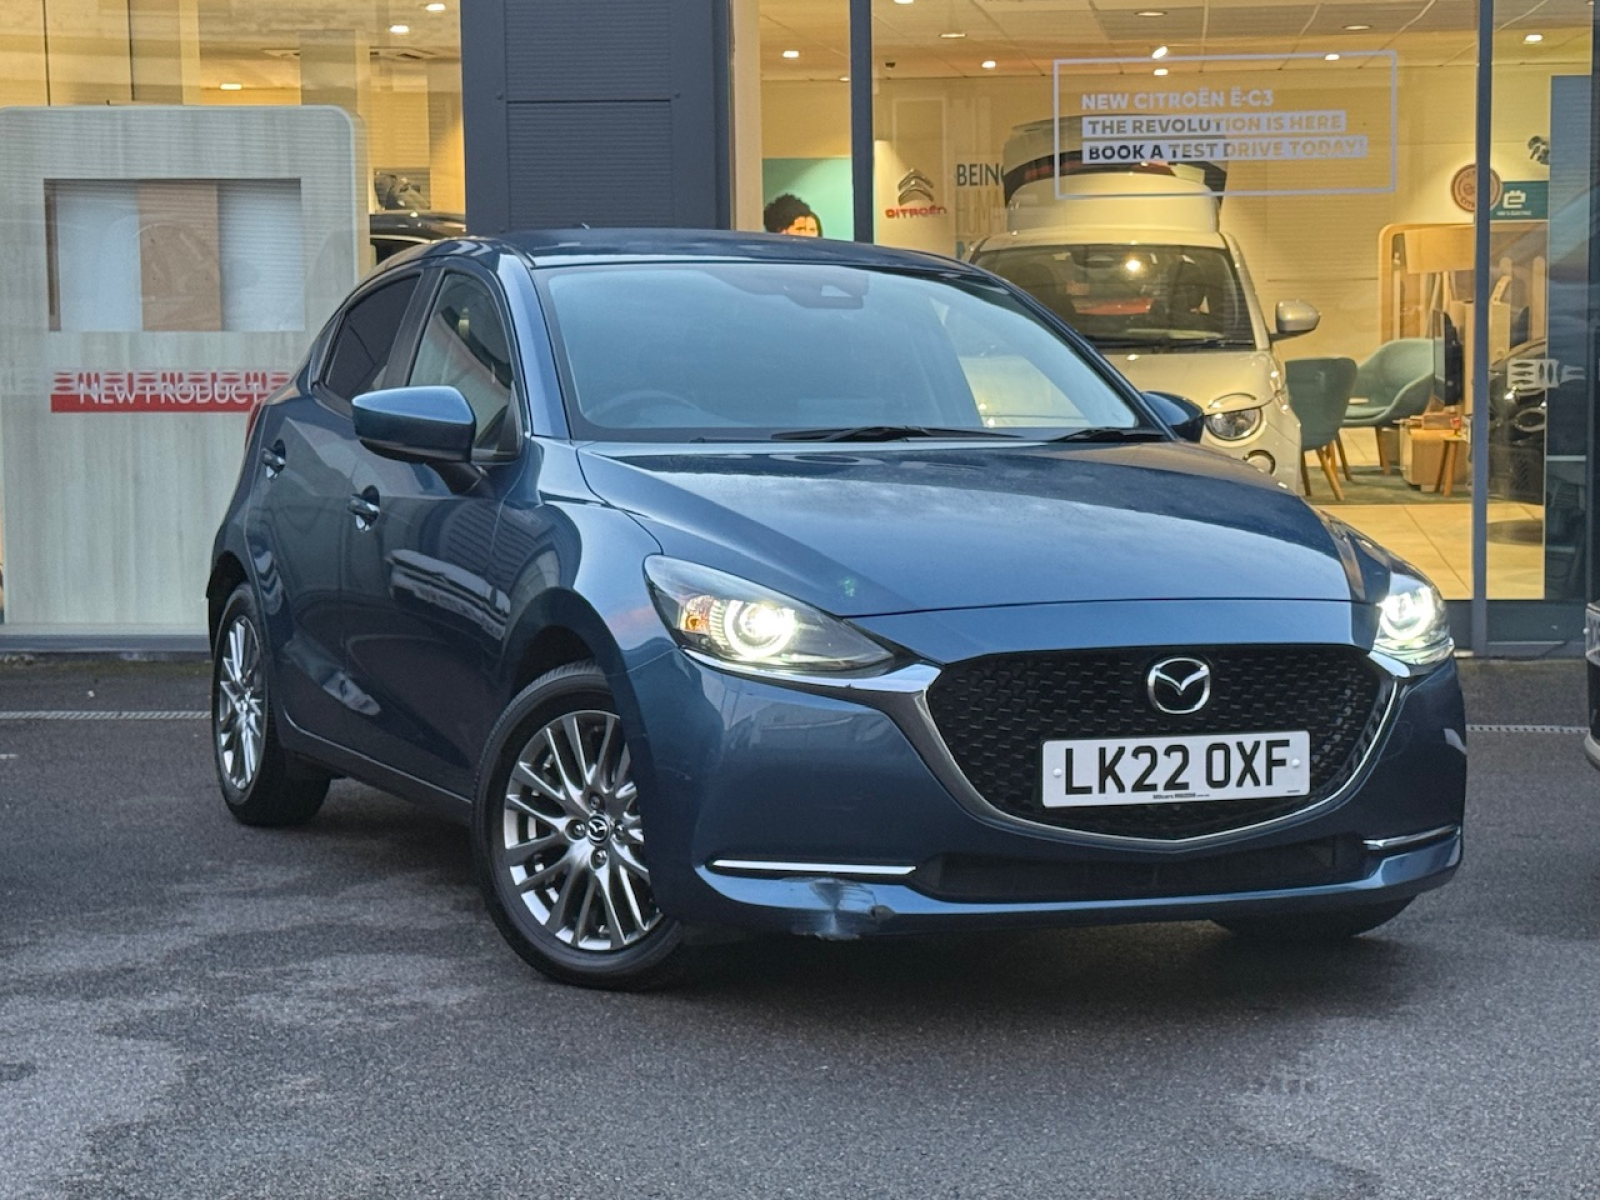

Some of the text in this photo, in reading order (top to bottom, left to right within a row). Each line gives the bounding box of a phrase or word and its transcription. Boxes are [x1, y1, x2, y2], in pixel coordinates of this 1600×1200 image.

[1082, 92, 1129, 110] NEW
[1134, 88, 1225, 109] CITROËN
[1088, 114, 1341, 134] THE REVOLUTION IS HERE
[1089, 144, 1145, 160] BOOK
[1150, 144, 1164, 159] A
[1168, 142, 1218, 158] TEST
[1223, 141, 1283, 157] DRIVE
[79, 382, 135, 404] NEW
[1065, 739, 1290, 795] LK22 OXF
